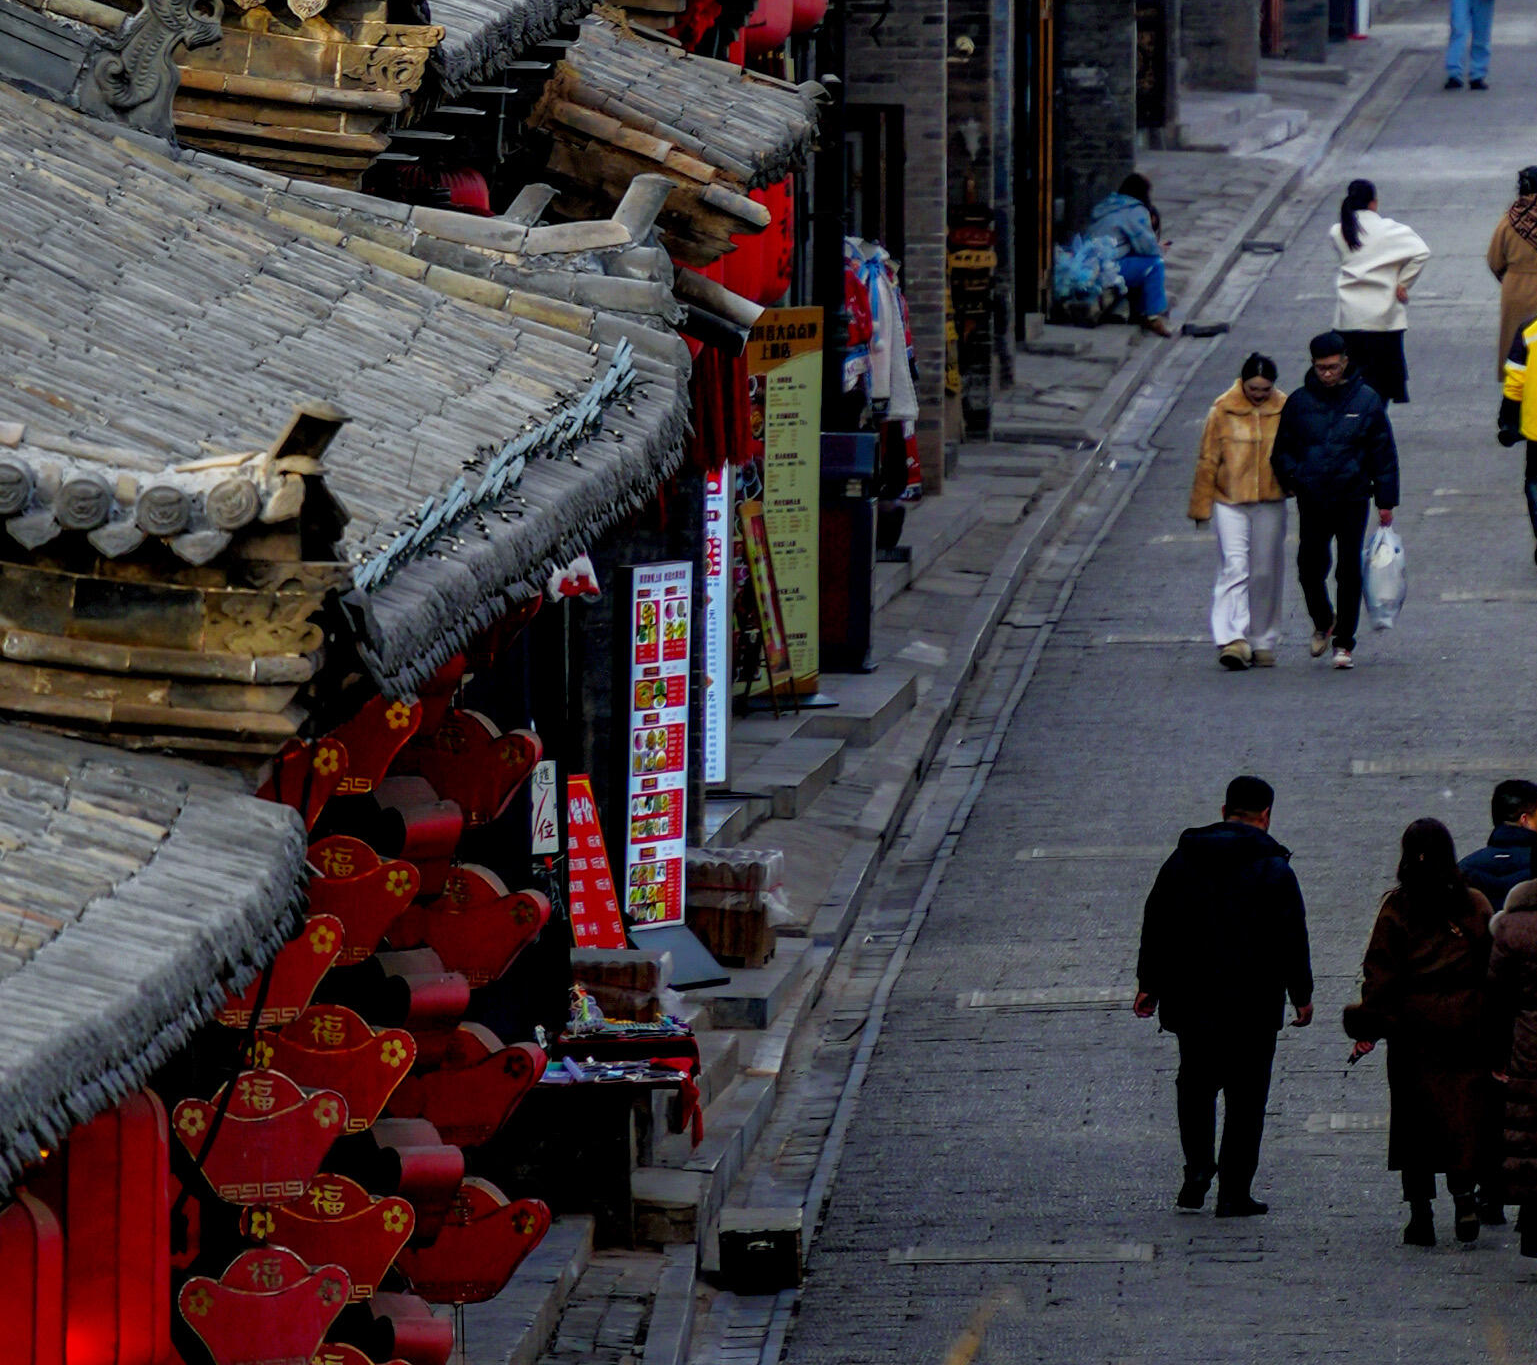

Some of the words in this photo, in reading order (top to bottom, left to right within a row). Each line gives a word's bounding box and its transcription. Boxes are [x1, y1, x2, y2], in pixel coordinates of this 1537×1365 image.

[320, 847, 354, 876] 福
[309, 1014, 345, 1045] 福
[237, 1079, 275, 1111] 福
[308, 1184, 345, 1215] 福
[247, 1258, 283, 1289] 福
